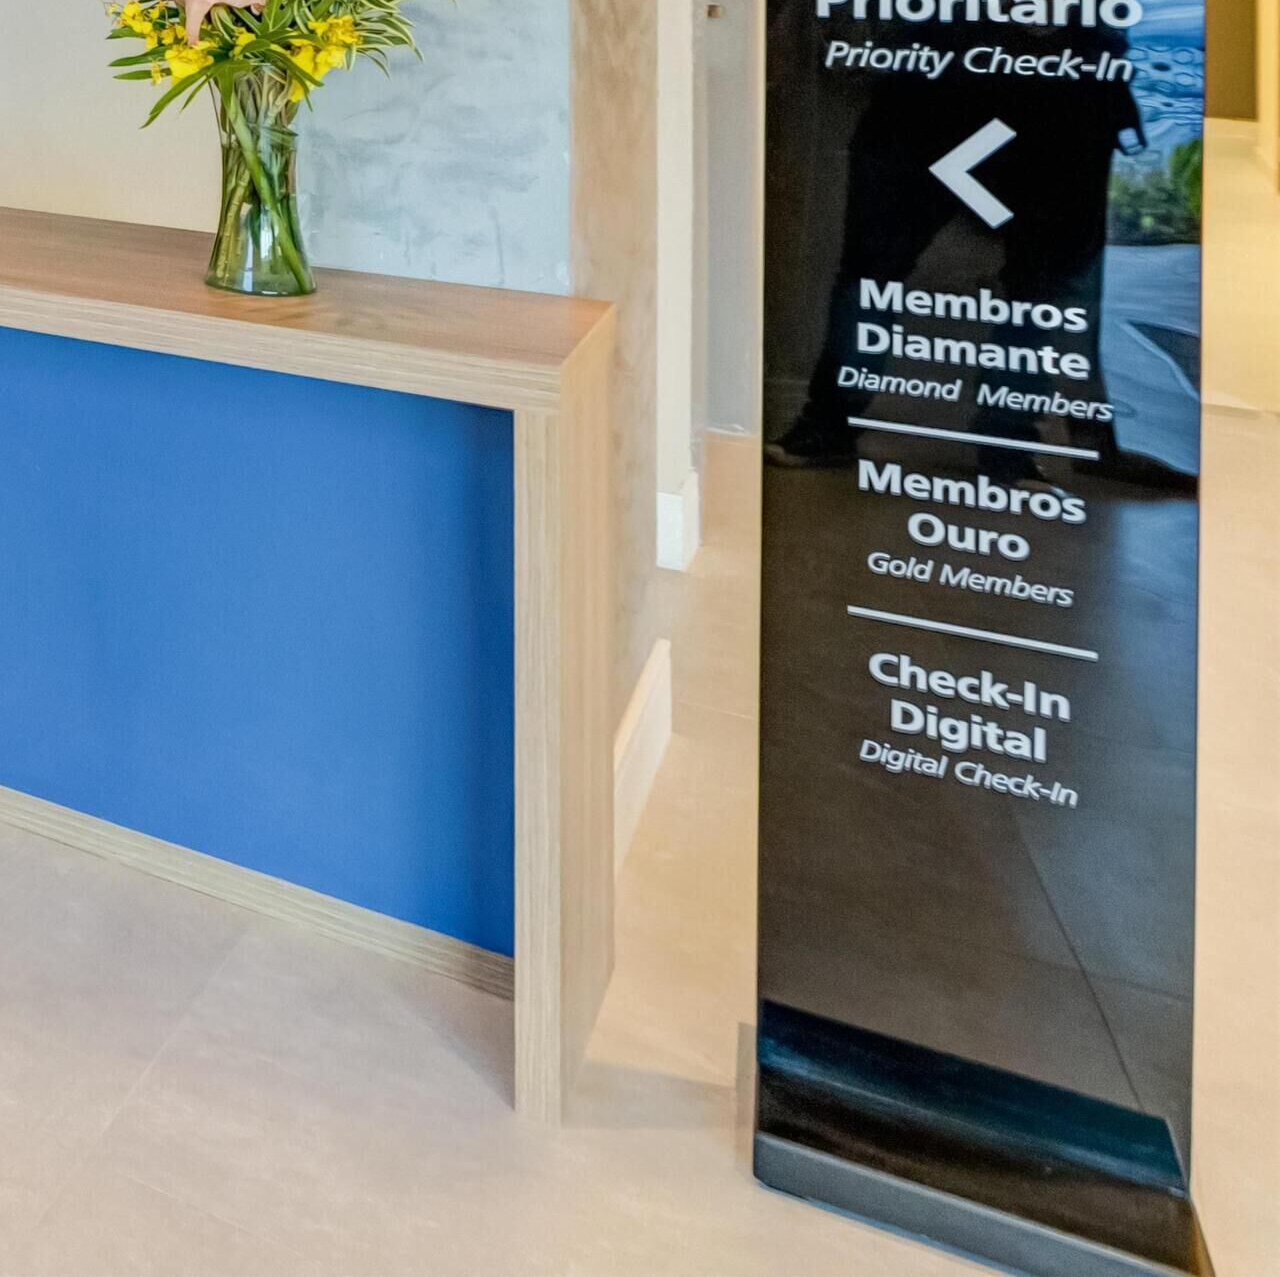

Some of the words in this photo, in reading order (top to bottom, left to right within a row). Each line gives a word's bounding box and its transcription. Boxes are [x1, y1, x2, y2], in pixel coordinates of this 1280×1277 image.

[825, 41, 953, 79] Priority
[964, 46, 1133, 81] Check-In
[859, 278, 1089, 332] Membros
[856, 322, 1091, 379] Diamante
[837, 366, 962, 402] Diamond
[977, 383, 1114, 422] Members
[858, 459, 1087, 523] Membros
[907, 513, 1030, 561] Ouro
[867, 552, 934, 583] Gold
[939, 563, 1074, 607] Members
[868, 652, 1071, 721] Check-In
[890, 698, 1047, 763] Digital
[859, 739, 948, 779] Digital
[953, 761, 1077, 808] Check-In
